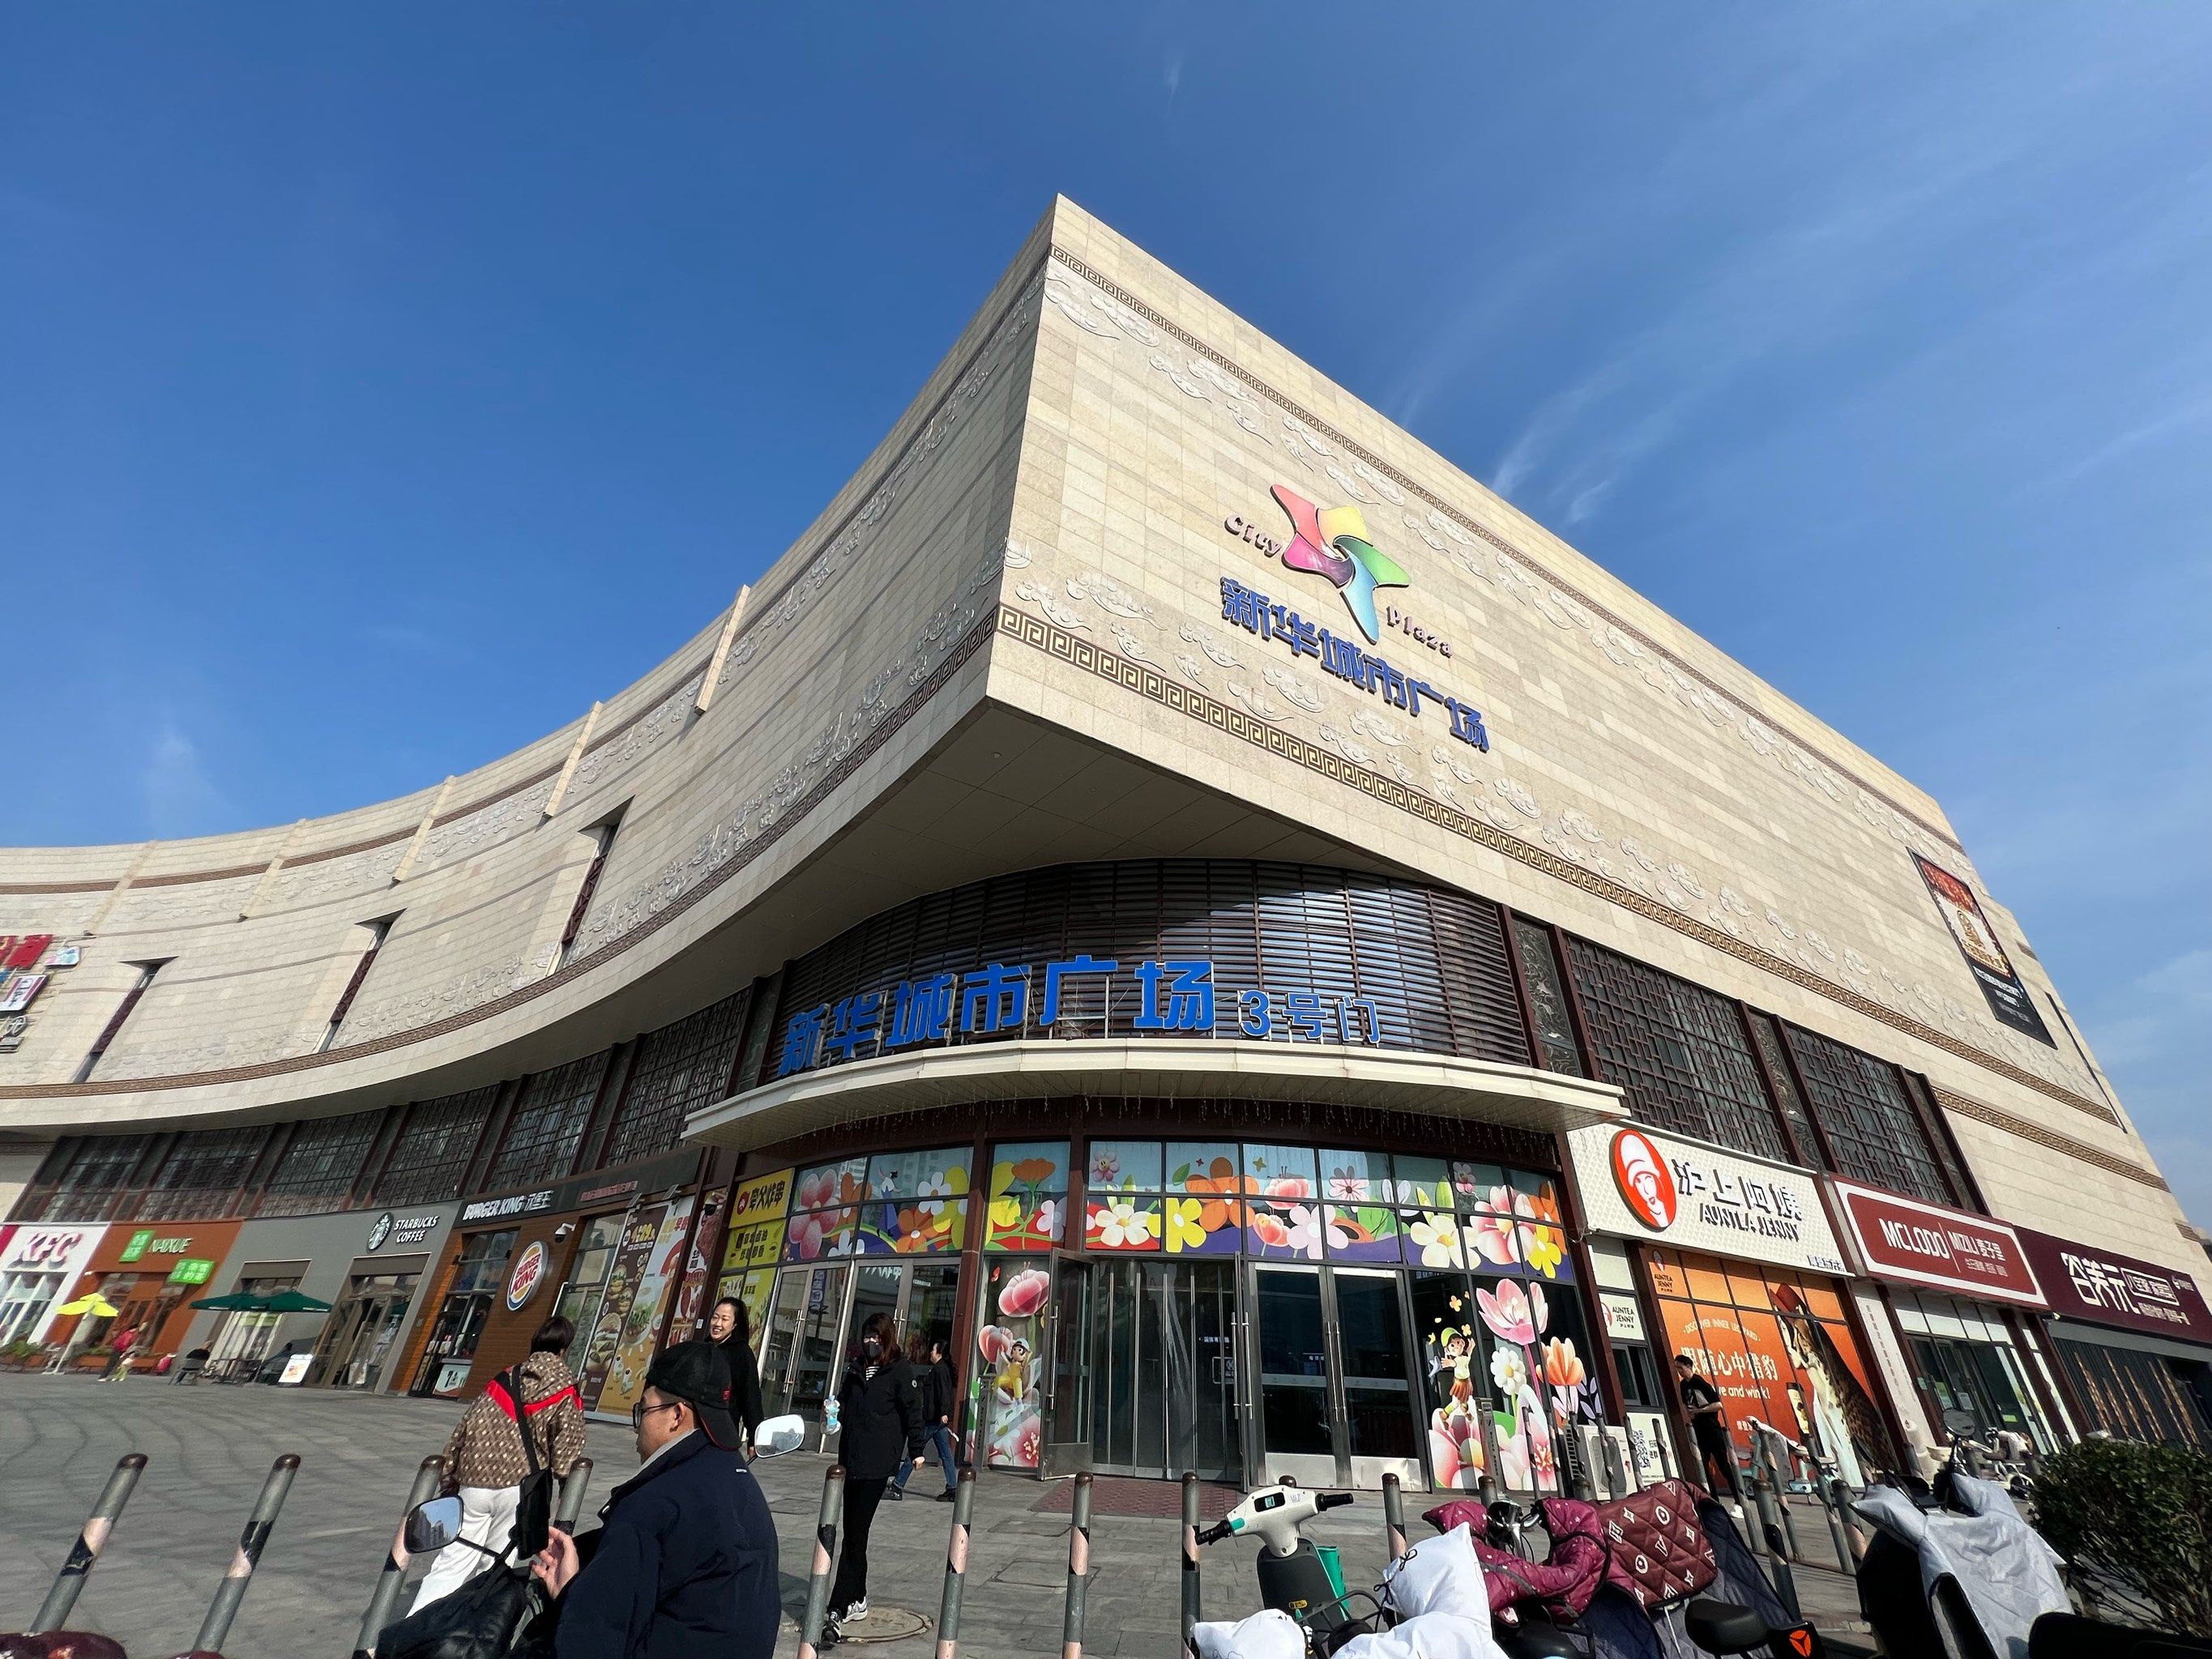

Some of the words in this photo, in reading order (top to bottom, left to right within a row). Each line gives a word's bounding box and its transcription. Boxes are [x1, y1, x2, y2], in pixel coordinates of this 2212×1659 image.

[1224, 514, 1282, 557] City
[1386, 605, 1452, 659] Plaza
[1220, 576, 1490, 752] 新华城市广场
[777, 954, 1214, 1077] 新华城市广场
[1240, 989, 1380, 1043] 3号门
[1672, 1159, 1803, 1221] 沪上阿姨
[463, 1200, 501, 1220] BURGER
[497, 1195, 525, 1215] KING
[394, 1215, 439, 1230] STARBUCKS
[1757, 1215, 1800, 1242] JENNY
[19, 1231, 83, 1265] KFC
[147, 1237, 194, 1254] NAIXUE
[396, 1230, 426, 1243] COFFEE
[1878, 1218, 1950, 1259] MCLODO
[1975, 1239, 2006, 1261] 麦子里
[512, 1265, 539, 1291] KING
[1654, 1274, 1673, 1282] AUNTEA
[1612, 1306, 1635, 1316] AUNTEA
[1616, 1314, 1634, 1324] JENNY
[1685, 1319, 1711, 1334] DISCVER
[1728, 1384, 1744, 1397] and
[1745, 1385, 1770, 1400] wink!
